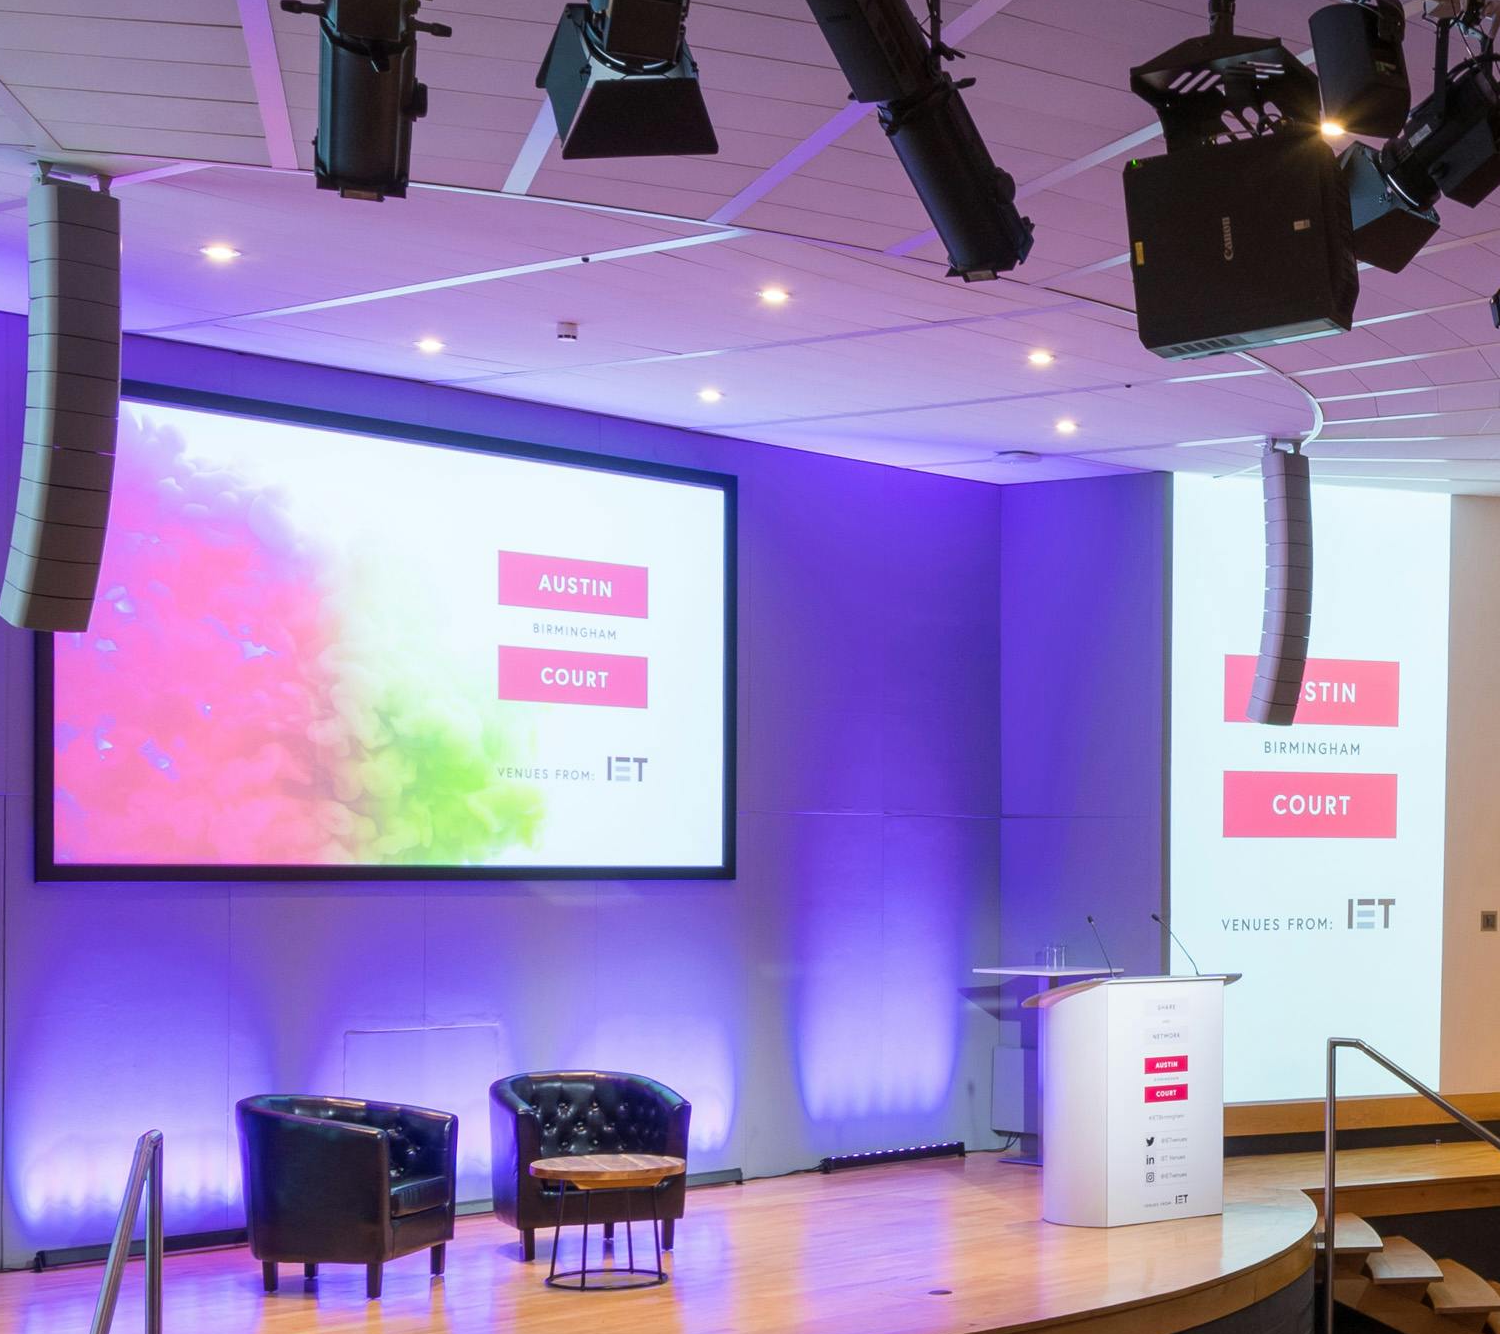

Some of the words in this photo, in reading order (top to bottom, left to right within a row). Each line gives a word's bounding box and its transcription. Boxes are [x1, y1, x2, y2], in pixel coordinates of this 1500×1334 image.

[1222, 216, 1234, 261] Canon
[538, 573, 612, 598] AUSTIN
[532, 622, 618, 641] BIRMINGHAM
[540, 666, 609, 688] COURT
[1303, 680, 1356, 704] STIN
[1264, 740, 1361, 756] BIRMINGHAM
[497, 767, 549, 780] VENUES
[555, 769, 596, 781] FROM:
[607, 756, 649, 783] IET
[1272, 794, 1351, 816] COURT
[1221, 917, 1281, 932] VENUES
[1287, 918, 1334, 932] FROM:
[1347, 898, 1396, 930] IET
[1155, 1061, 1178, 1069] AUSTIN
[1174, 1194, 1188, 1204] IET
